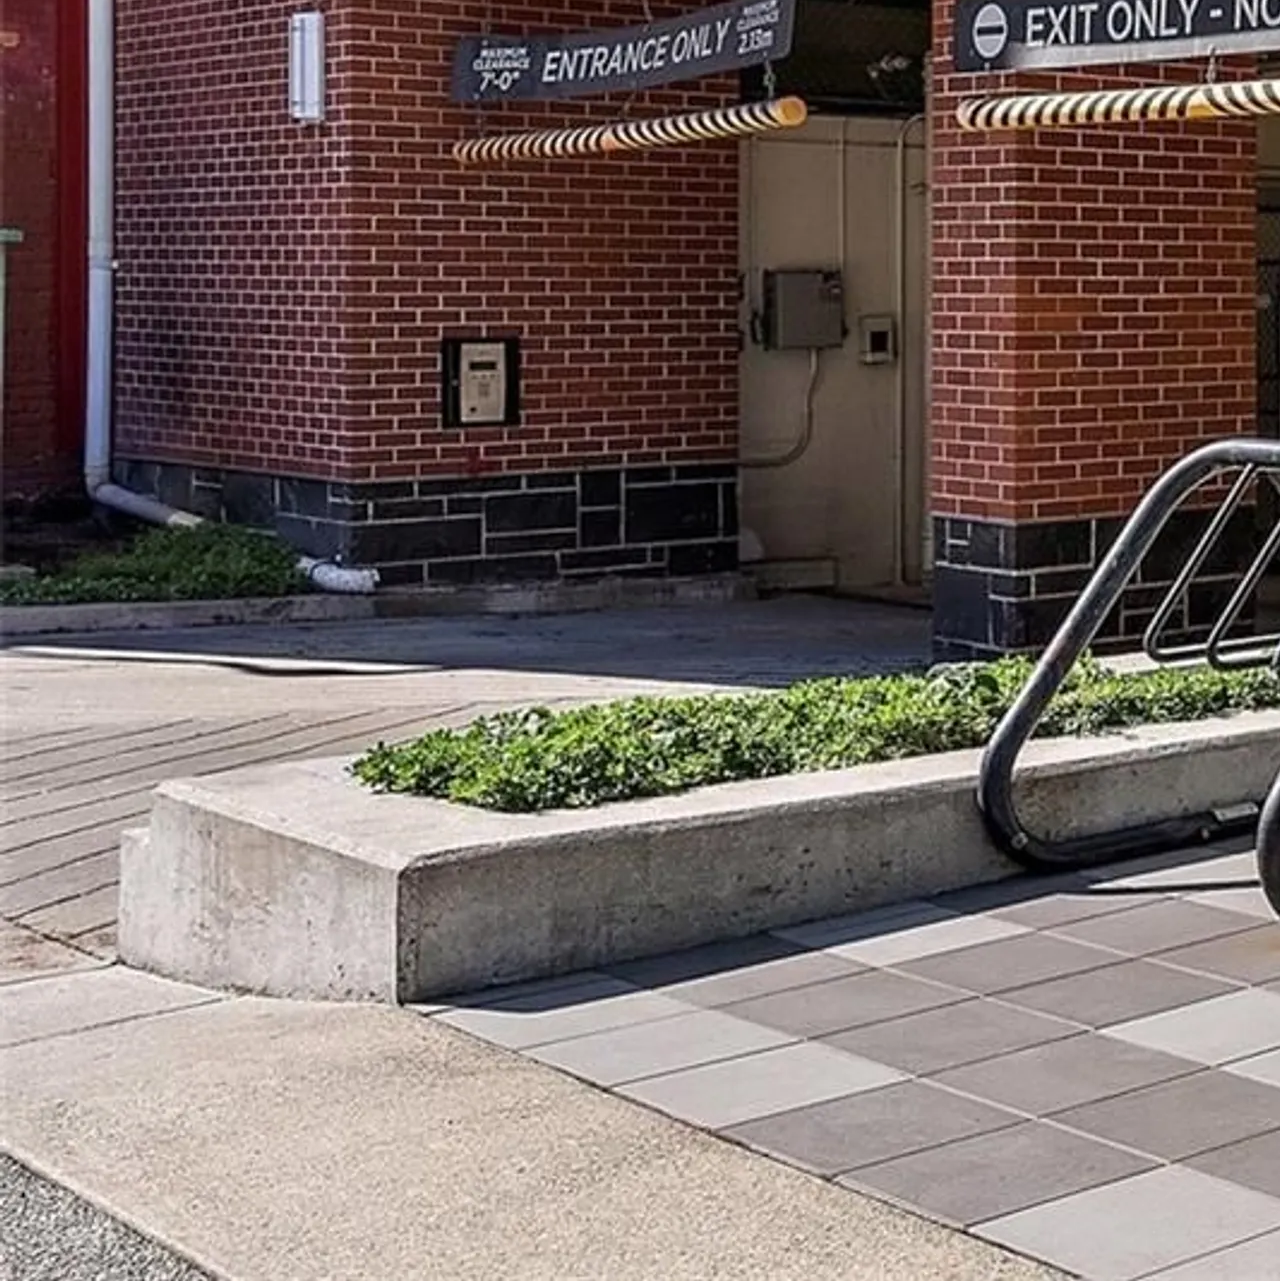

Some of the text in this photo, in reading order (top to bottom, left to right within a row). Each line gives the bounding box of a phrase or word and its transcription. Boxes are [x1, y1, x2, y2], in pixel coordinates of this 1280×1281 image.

[542, 18, 732, 83] ENTRANCE ONLY
[1025, 2, 1099, 47] EXIT
[1208, 7, 1223, 18] -
